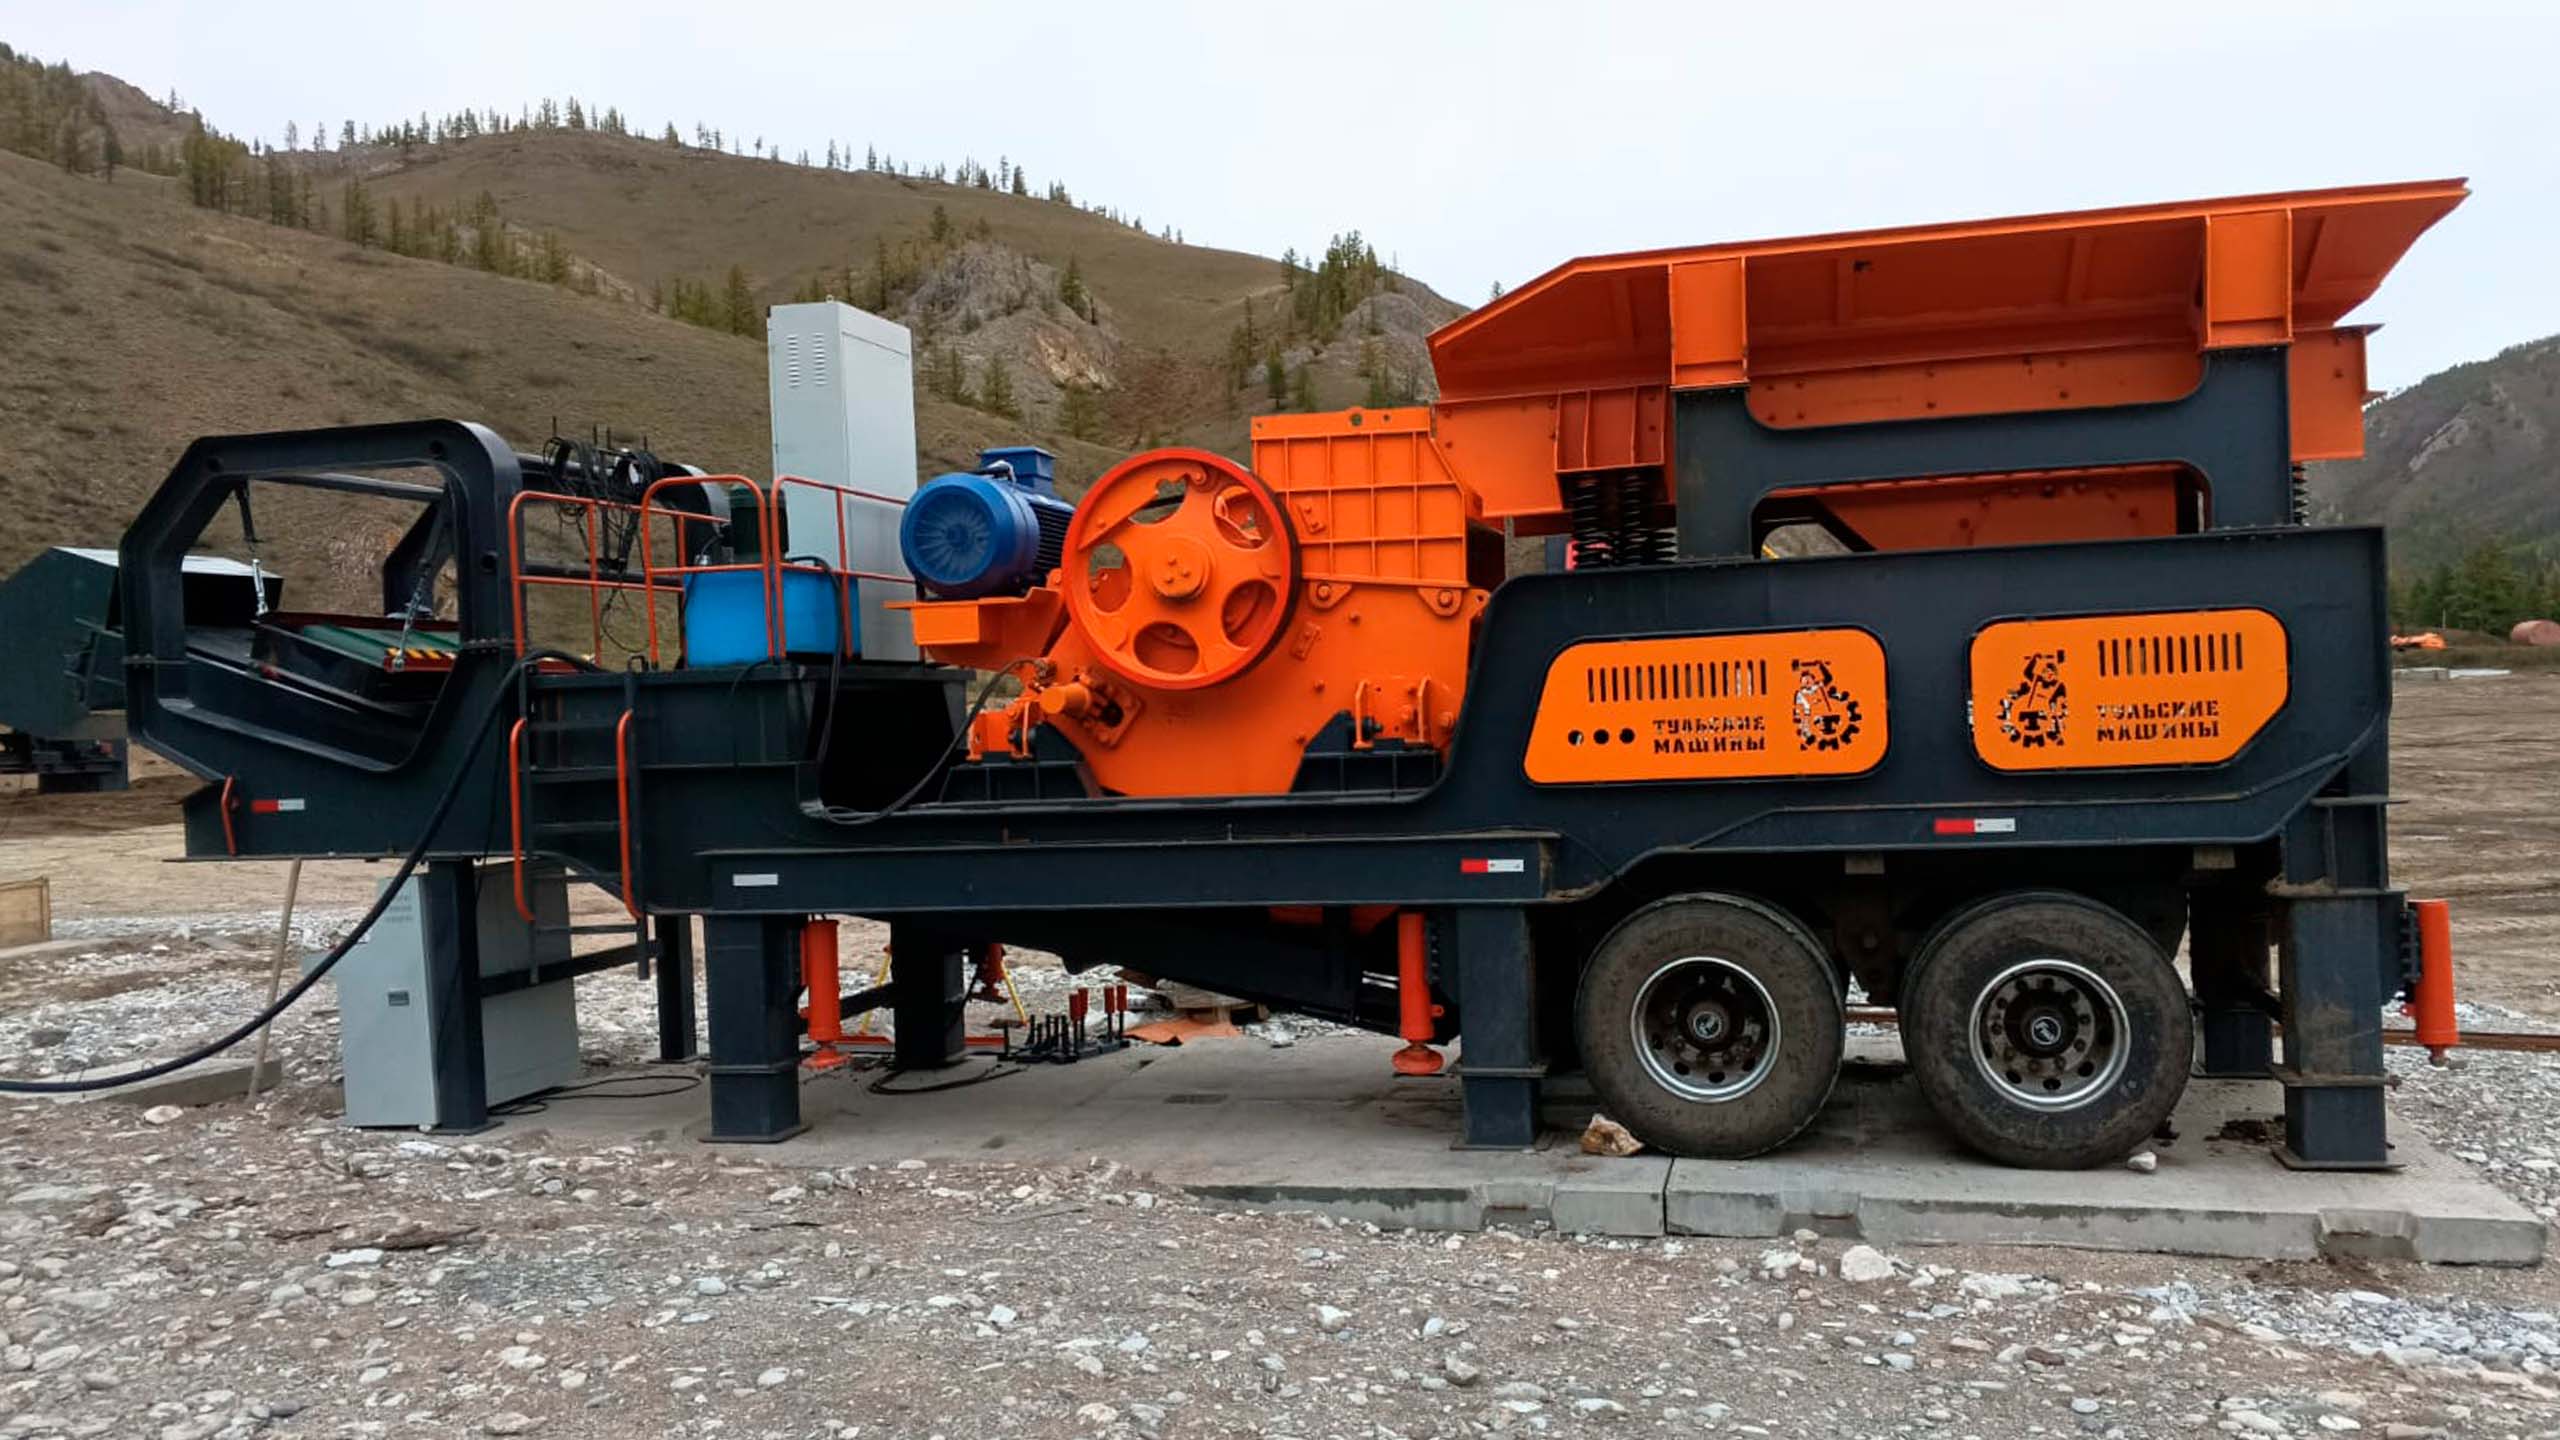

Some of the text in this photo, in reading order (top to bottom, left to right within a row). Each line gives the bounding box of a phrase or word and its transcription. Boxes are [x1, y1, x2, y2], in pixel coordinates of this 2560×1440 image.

[2096, 700, 2219, 720] ТУЛЬСКИЕ
[2096, 720, 2219, 742] МАШИНЫ
[1653, 737, 1766, 754] МАШИНЫ
